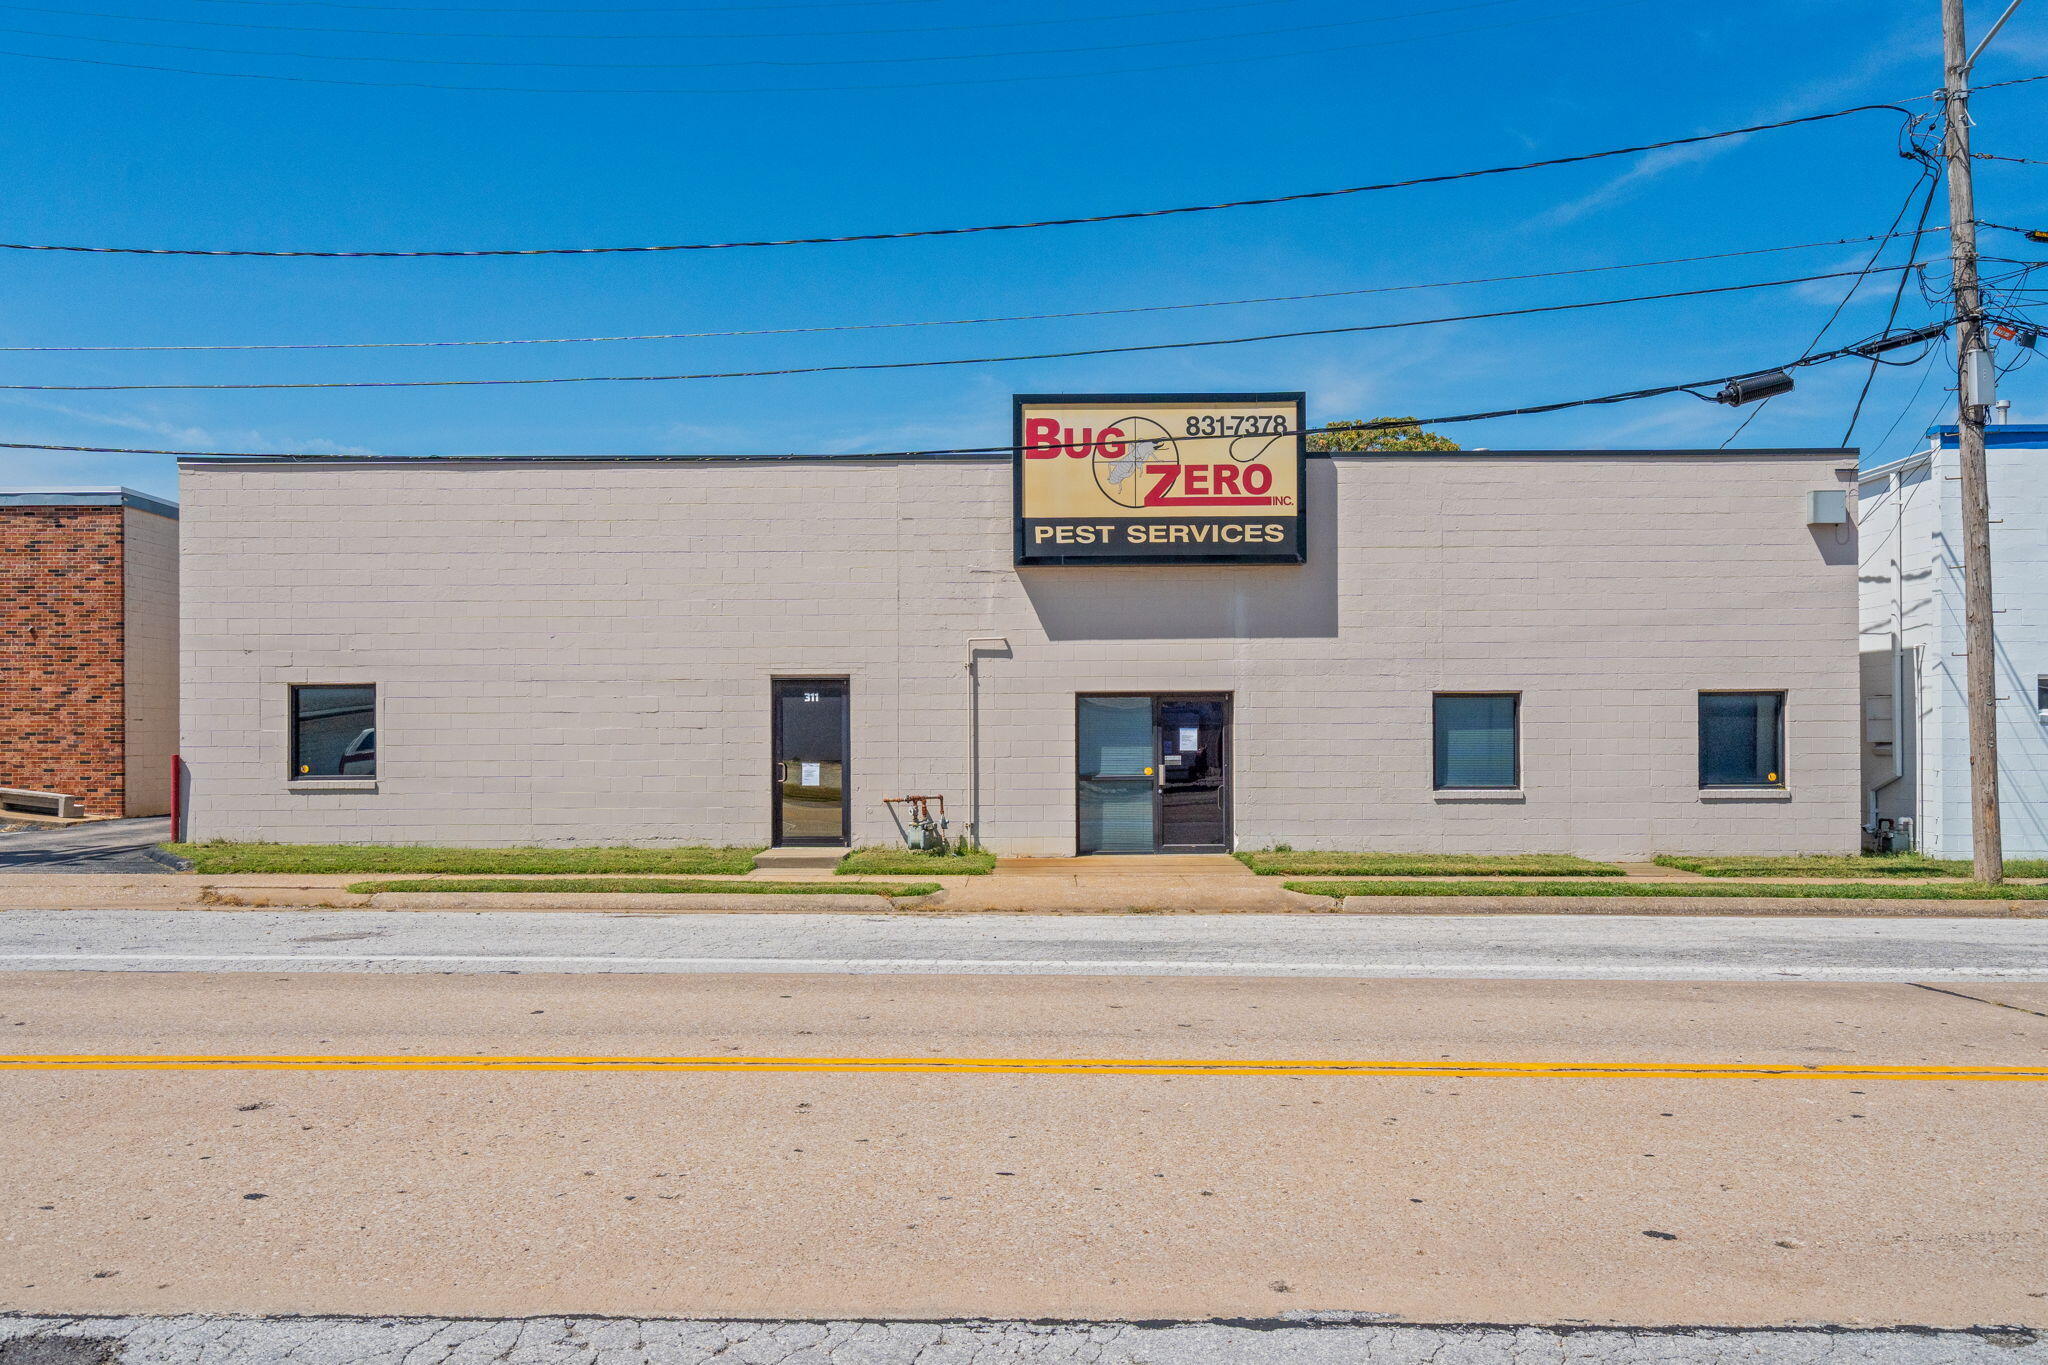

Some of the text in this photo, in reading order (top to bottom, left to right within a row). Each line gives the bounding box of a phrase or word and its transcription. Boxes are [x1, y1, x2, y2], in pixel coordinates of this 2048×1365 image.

[1186, 415, 1287, 436] 831-7378
[1144, 464, 1294, 507] ZERO INC.
[1034, 524, 1285, 544] PEST SERVICES
[804, 693, 819, 702] 311
